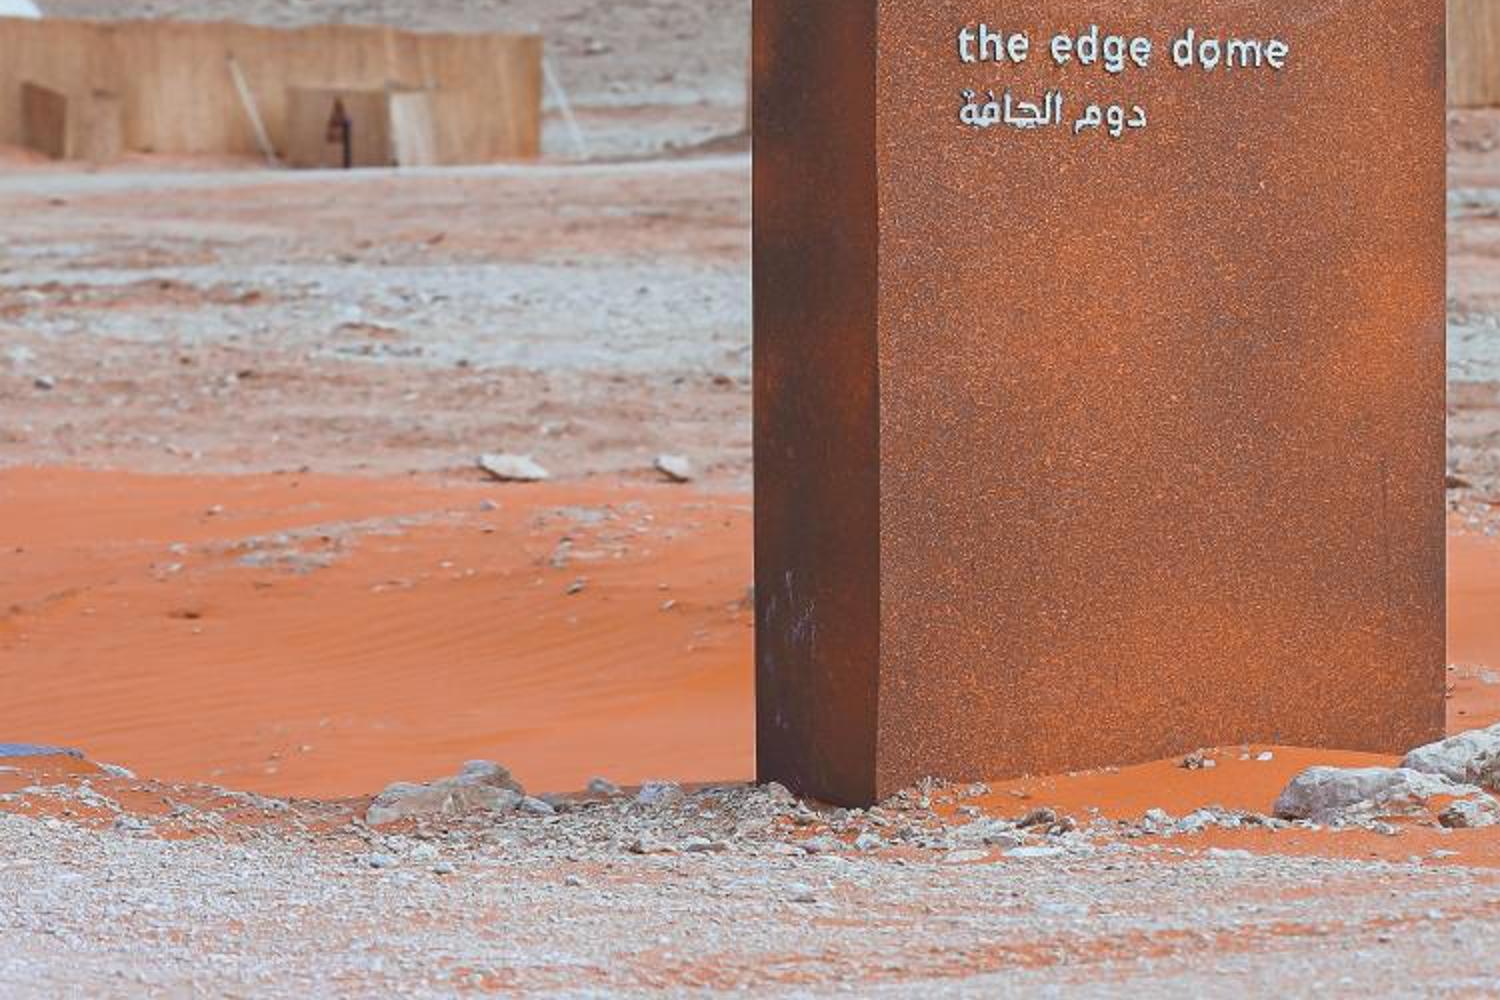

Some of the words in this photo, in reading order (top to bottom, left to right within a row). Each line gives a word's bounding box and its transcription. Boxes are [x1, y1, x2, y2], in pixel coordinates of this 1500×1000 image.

[957, 23, 1029, 63] the
[1051, 24, 1154, 73] edge
[1172, 27, 1289, 69] dome
[958, 89, 1064, 129] الحافة
[1073, 103, 1148, 137] دوم
